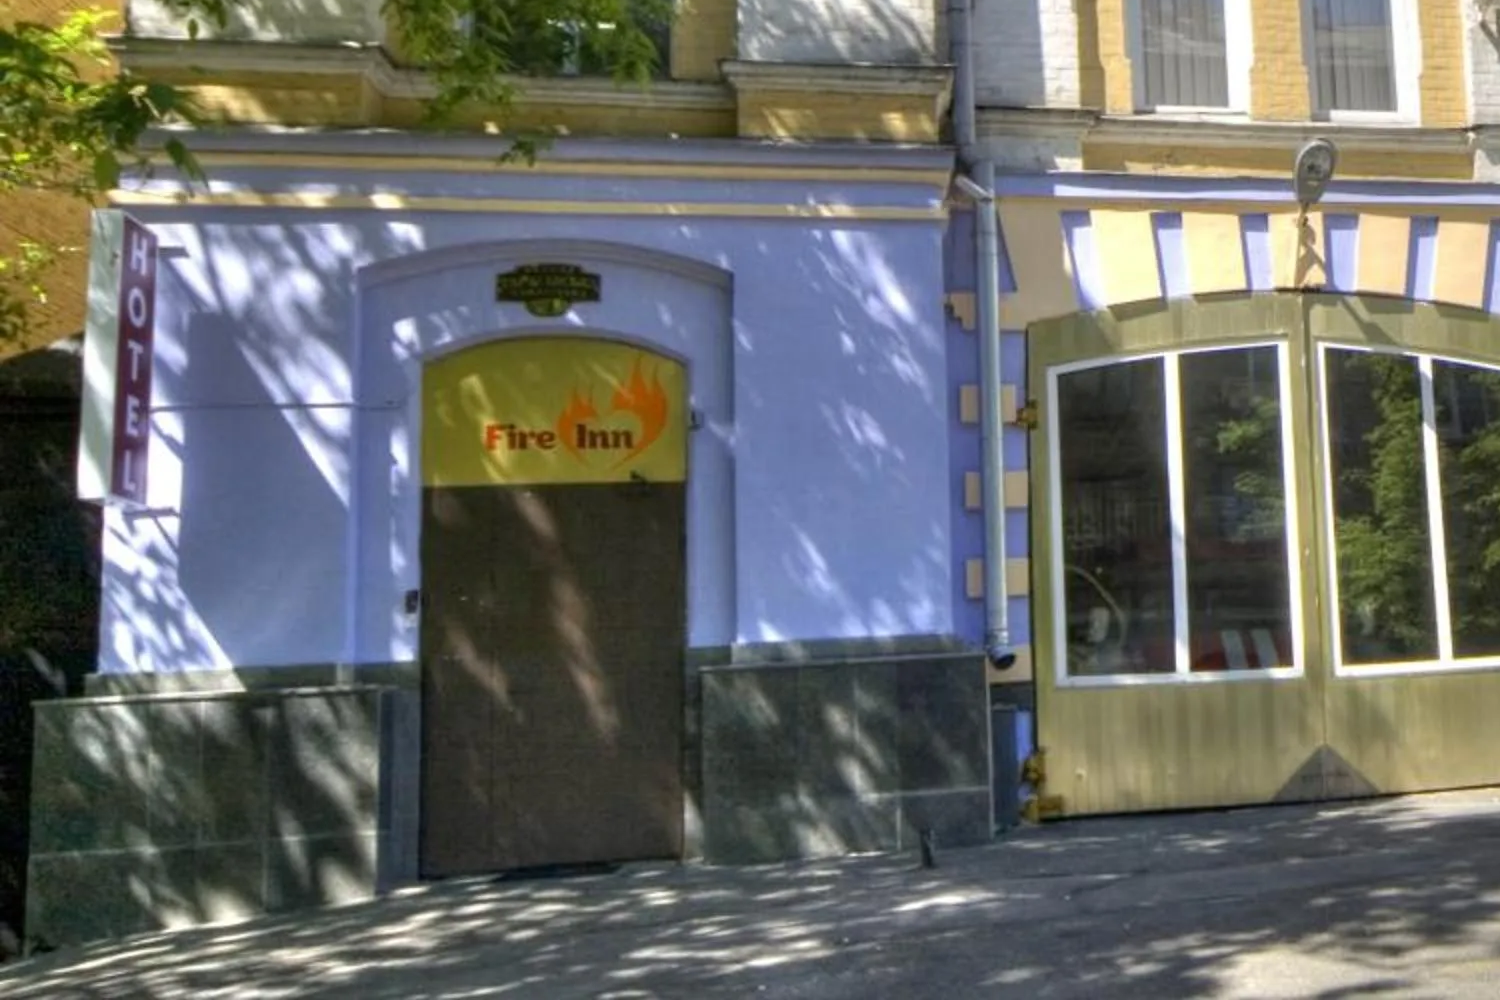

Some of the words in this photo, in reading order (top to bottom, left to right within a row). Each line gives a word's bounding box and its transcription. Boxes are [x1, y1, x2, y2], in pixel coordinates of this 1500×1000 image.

[122, 230, 148, 492] HOTEL
[486, 423, 556, 450] Fire
[575, 422, 634, 450] Inn
